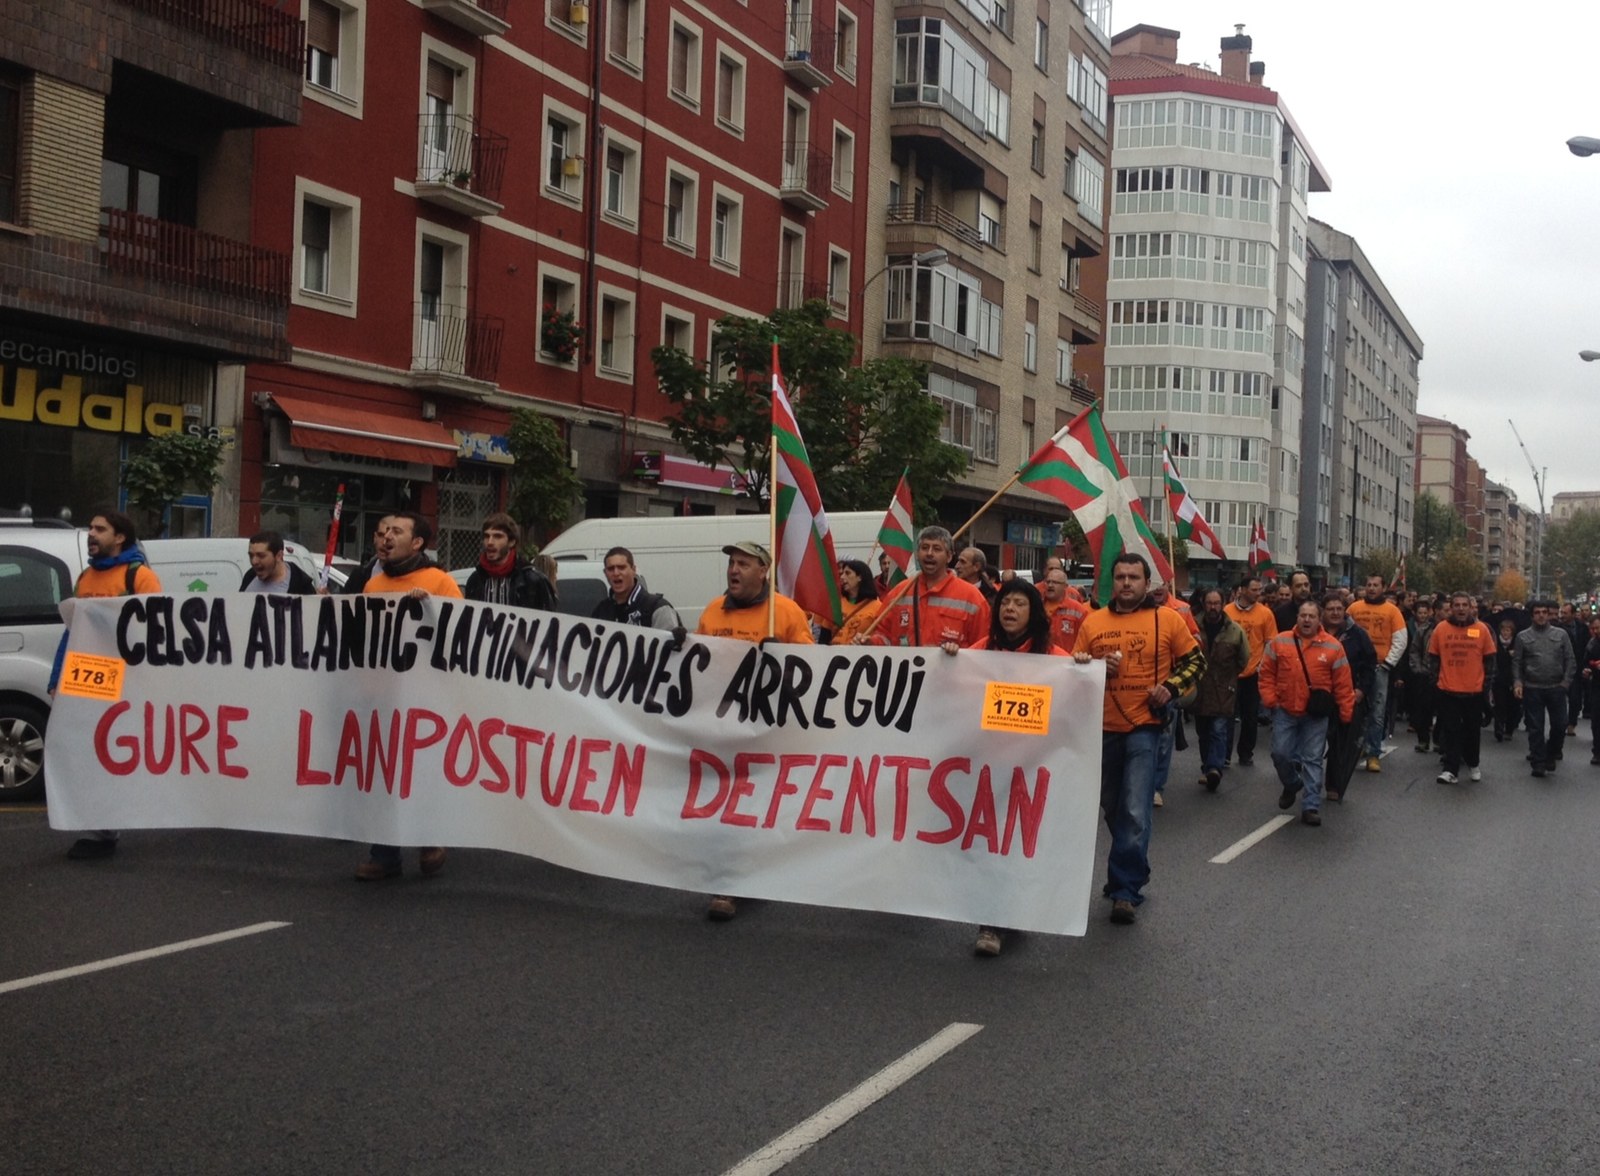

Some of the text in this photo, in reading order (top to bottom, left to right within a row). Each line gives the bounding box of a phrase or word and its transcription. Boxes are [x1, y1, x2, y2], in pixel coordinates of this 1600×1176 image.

[71, 667, 105, 685] 178
[116, 596, 232, 666] CELSA
[715, 645, 926, 733] ARREGUi
[993, 699, 1029, 717] 178
[93, 700, 1051, 858] GURE LANPOSTUEN DEFENTSAN
